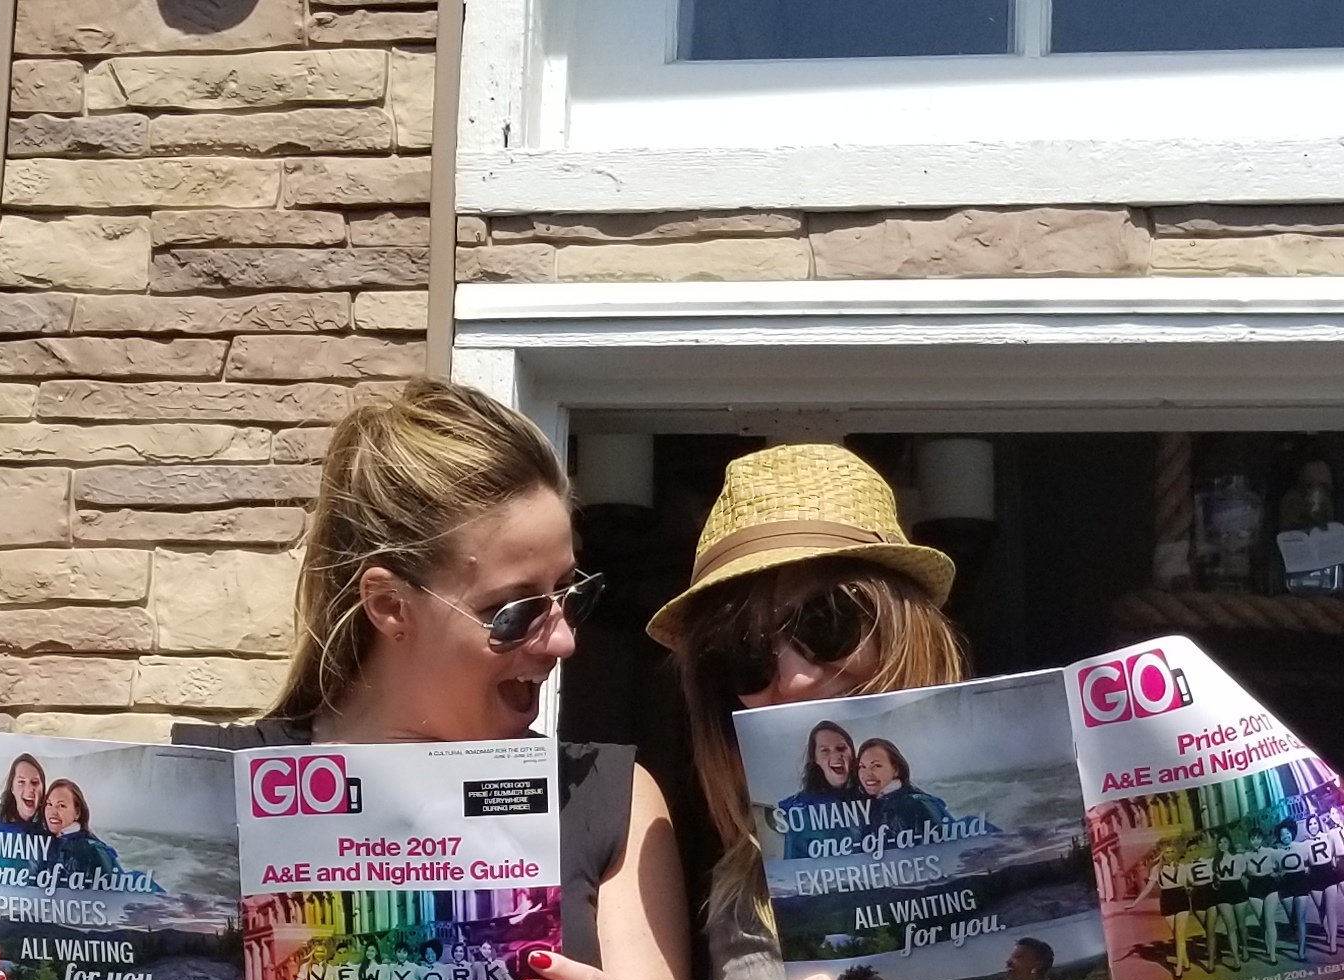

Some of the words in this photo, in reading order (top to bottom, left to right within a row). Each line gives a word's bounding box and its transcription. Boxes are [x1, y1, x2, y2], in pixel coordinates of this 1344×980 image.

[1177, 724, 1238, 756] Pride
[1240, 713, 1274, 738] 2017
[1102, 766, 1153, 794] A&E
[1157, 758, 1205, 785] and
[1209, 736, 1290, 776] Nightlife
[772, 805, 804, 834] SO
[808, 799, 873, 831] MANY
[808, 812, 988, 862] one-of-a-kind
[338, 837, 401, 858] Pride
[406, 837, 462, 856] 2017
[261, 864, 311, 886] A&E
[316, 862, 361, 883] and
[366, 862, 465, 885] Nightlife
[469, 859, 540, 881] Guide
[795, 854, 948, 897] EXPERIENCES.
[854, 902, 890, 930] ALL
[890, 888, 977, 926] WAITING
[20, 937, 52, 961] ALL
[54, 938, 134, 964] WAITING
[901, 923, 943, 957] for
[949, 914, 1006, 948] you.
